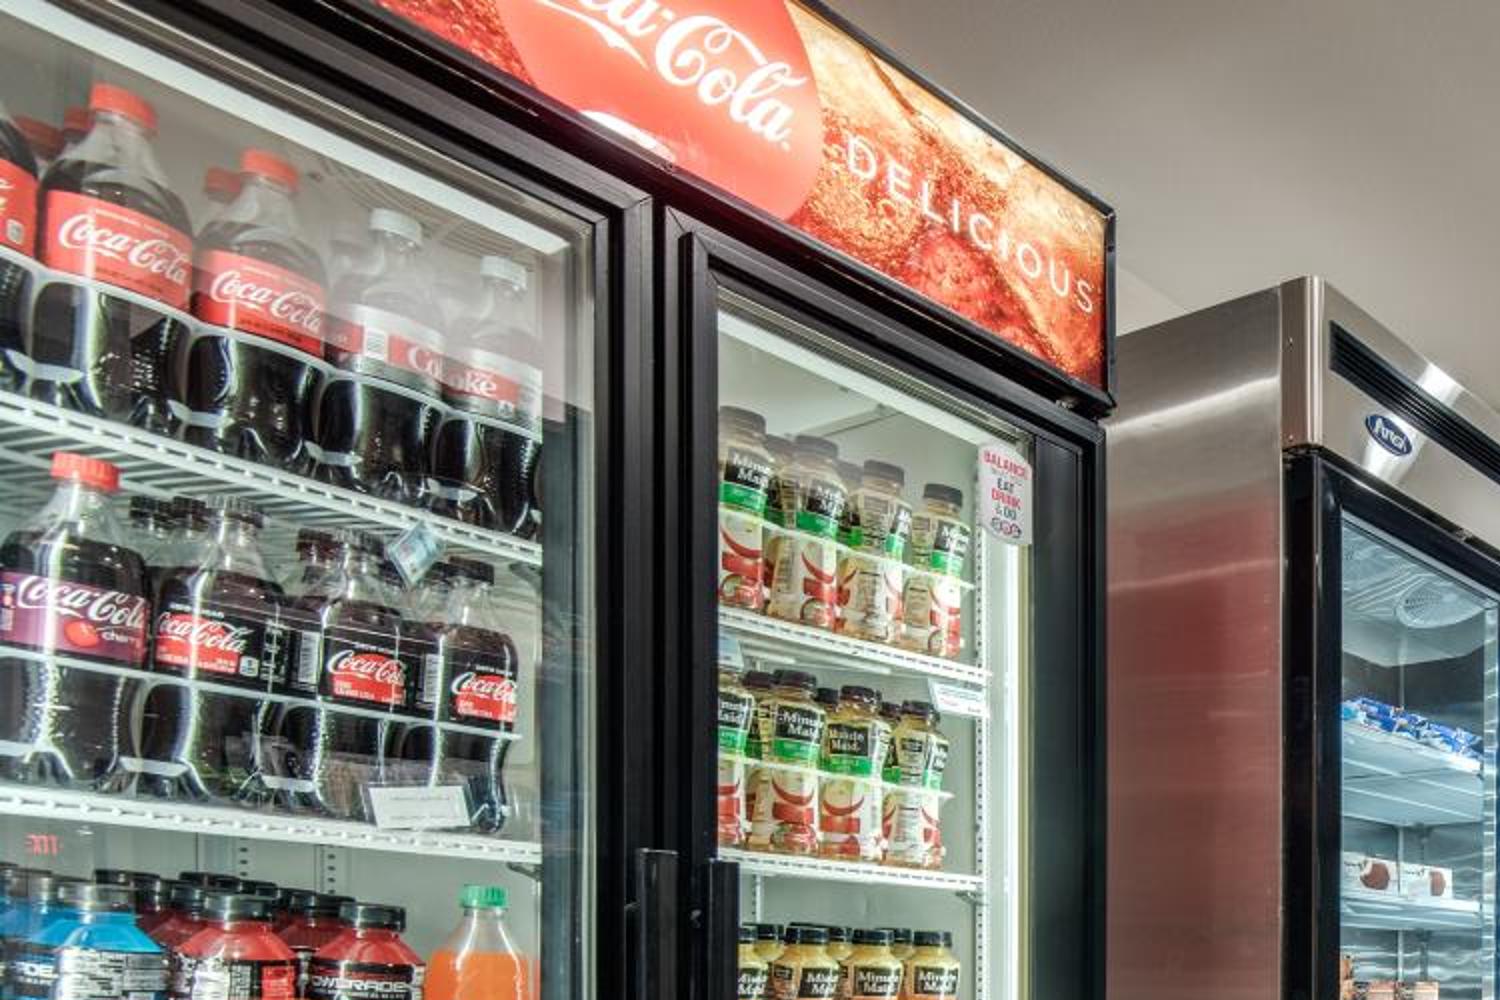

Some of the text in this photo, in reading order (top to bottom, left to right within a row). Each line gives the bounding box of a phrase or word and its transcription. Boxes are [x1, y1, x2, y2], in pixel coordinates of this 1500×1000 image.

[540, 0, 806, 151] a-Cola
[58, 213, 188, 285] Coca-Cola
[847, 133, 1094, 313] DELICIOUS
[210, 269, 322, 333] Coca-Cola
[17, 575, 145, 629] Coca-Col
